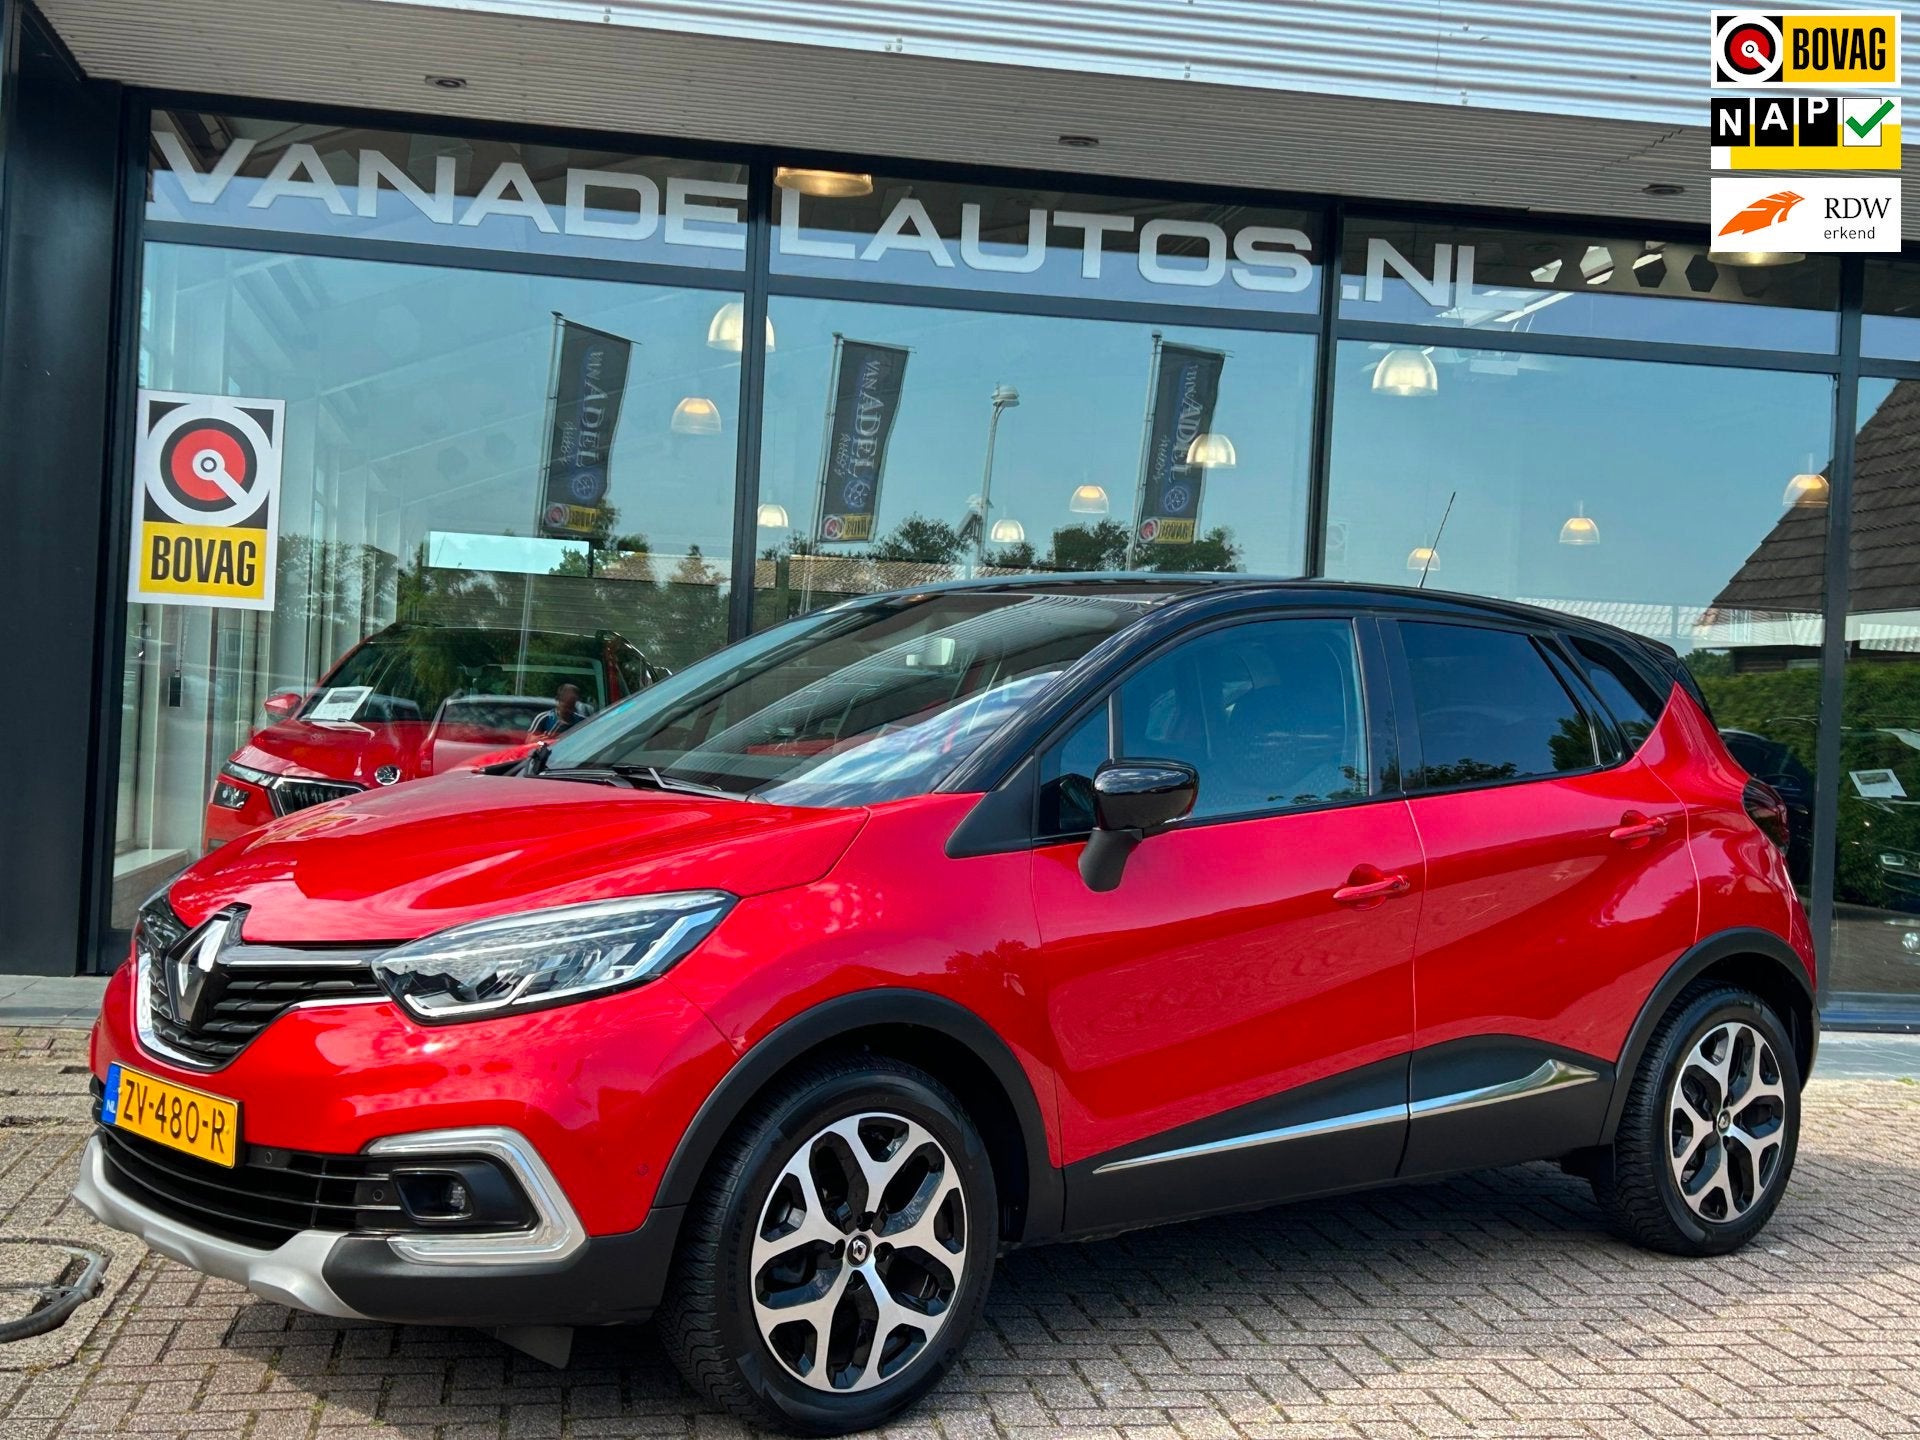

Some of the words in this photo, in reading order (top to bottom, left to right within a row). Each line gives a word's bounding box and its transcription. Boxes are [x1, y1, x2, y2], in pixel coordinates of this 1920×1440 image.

[151, 535, 257, 587] BOVAG
[106, 1100, 116, 1113] NL
[123, 1079, 226, 1154] ZV-480-R
